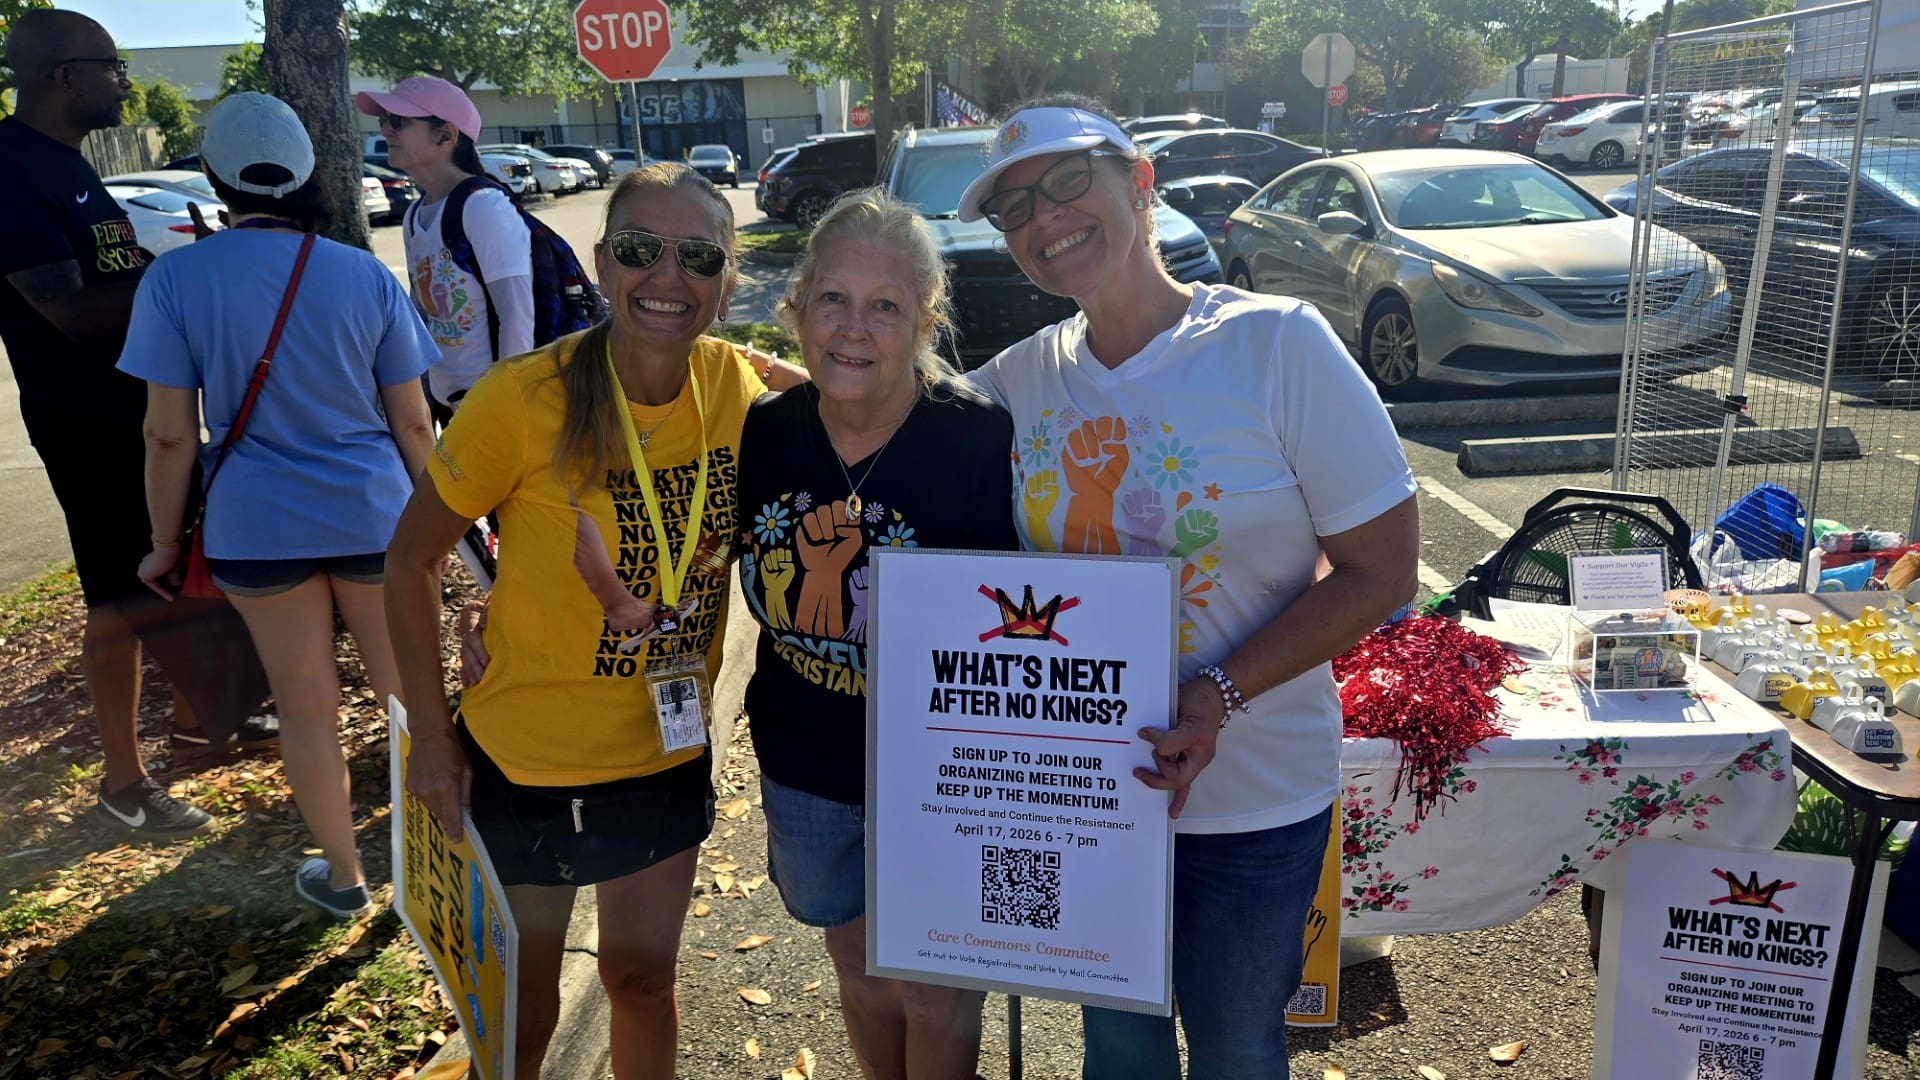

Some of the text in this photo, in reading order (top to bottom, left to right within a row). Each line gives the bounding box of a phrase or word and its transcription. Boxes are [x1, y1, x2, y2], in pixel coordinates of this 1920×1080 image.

[582, 10, 663, 51] STOP
[1328, 88, 1346, 99] STOP
[851, 111, 869, 121] STOP
[660, 486, 738, 520] KIGS
[618, 523, 657, 545] NO
[617, 545, 659, 567] NO
[1586, 562, 1614, 570] Support
[593, 656, 637, 678] NO
[931, 649, 1127, 694] WHAT'S NEXT
[929, 687, 1128, 726] AFTER NO KINGS?
[952, 746, 1102, 771] SIGN UP TO JOIN OUR
[938, 764, 1116, 790] ORGANIZING MEETING TO
[936, 782, 1119, 810] KEEP UP THE MOMENTUM!
[921, 803, 1134, 831] Stay Involved and Continue the Resistance!
[954, 823, 983, 837] April
[987, 826, 1006, 840] 17,
[1009, 827, 1041, 841] 2026
[1045, 831, 1053, 842] 6
[1066, 833, 1074, 844] 7
[1077, 836, 1098, 848] pm
[449, 849, 465, 988] AGUA
[1668, 906, 1831, 948] WHAT'S NEXT
[927, 928, 1111, 963] Care Commons Committee
[1663, 931, 1828, 969] AFTER NO KINGS?
[917, 949, 1129, 983] Get out to Vote Registration and Vote by Mail Committee
[1667, 982, 1814, 1012] ORGANIZING MEETING TO
[1680, 971, 1804, 997] SIGN UP TO JOIN OUR
[1651, 1007, 1670, 1017] Stay
[1671, 1009, 1705, 1021] Involved
[1707, 1015, 1722, 1024] and
[1723, 1016, 1759, 1029] Continue
[1761, 1023, 1776, 1032] the
[1664, 994, 1815, 1025] KEEP UP THE MOMENTUM!
[1678, 1022, 1702, 1036] April
[1706, 1027, 1720, 1039] 17,
[1723, 1030, 1750, 1042] 2026
[1752, 1033, 1760, 1042] 6
[1769, 1036, 1777, 1045] 7
[1779, 1039, 1796, 1050] pm
